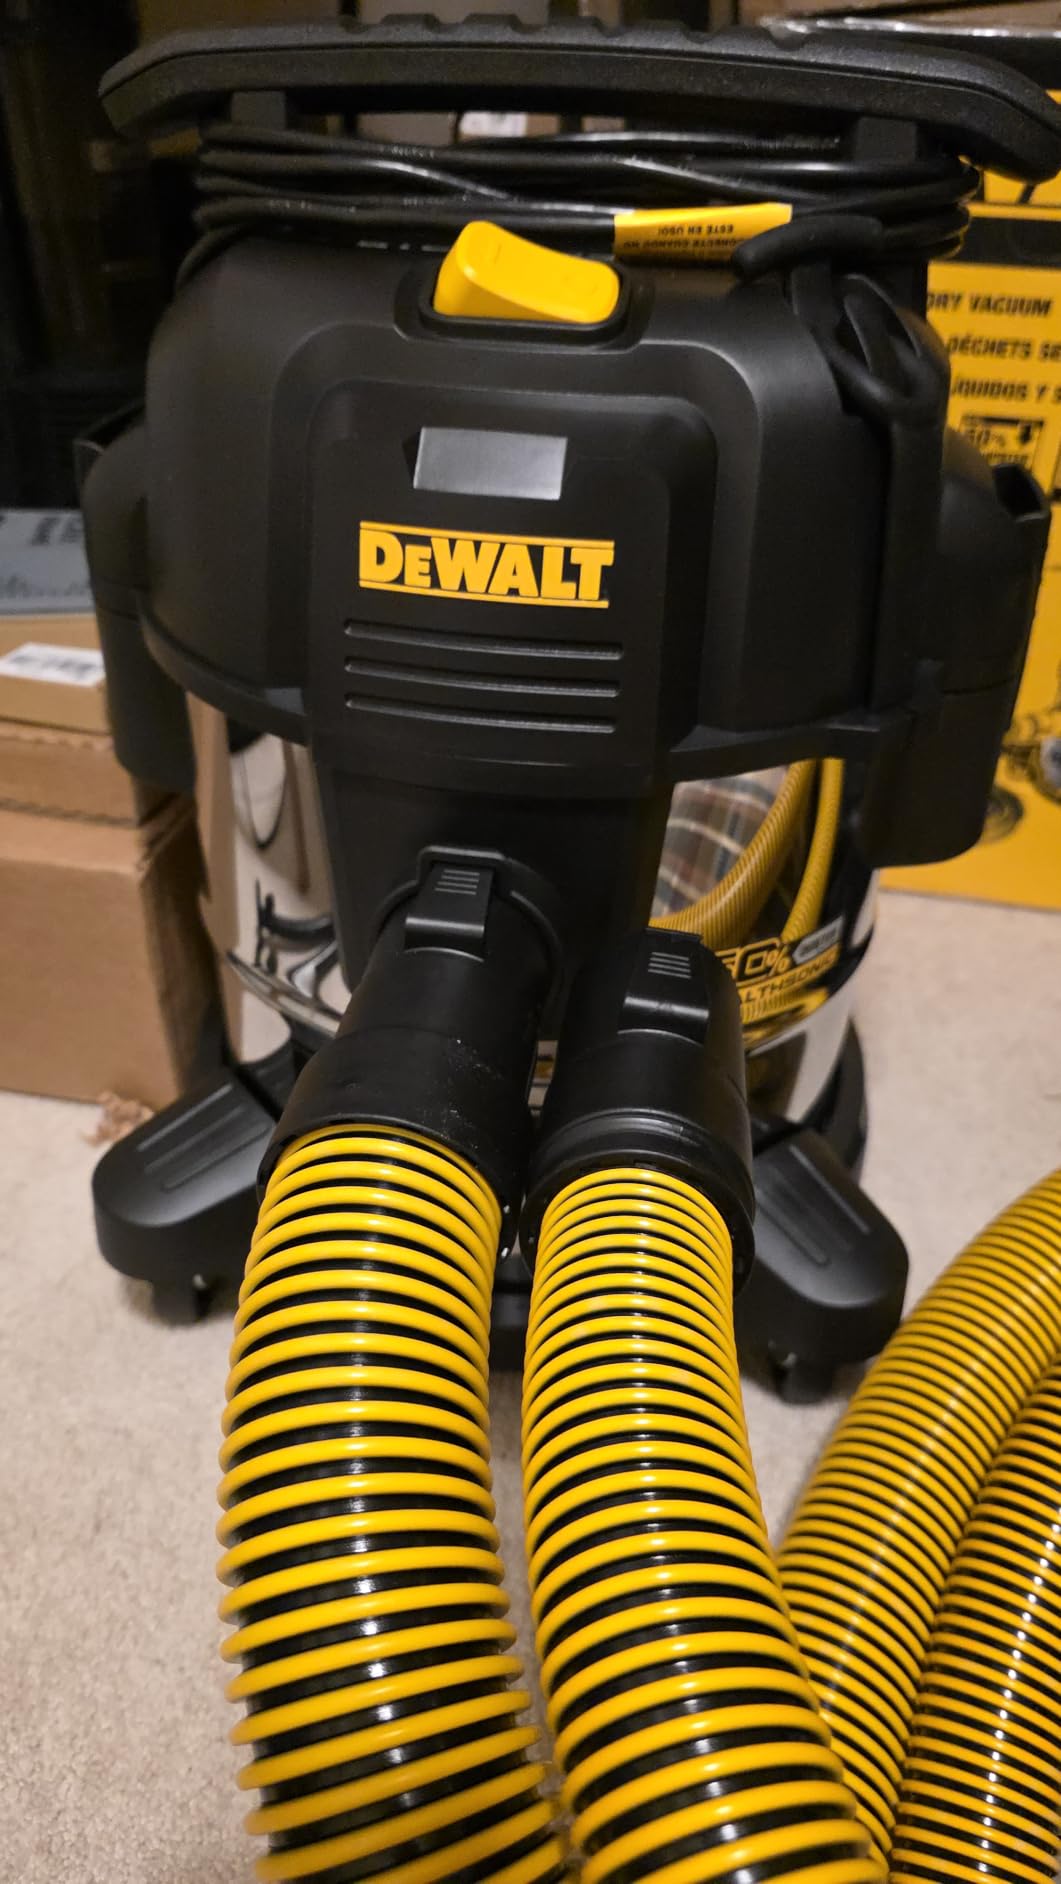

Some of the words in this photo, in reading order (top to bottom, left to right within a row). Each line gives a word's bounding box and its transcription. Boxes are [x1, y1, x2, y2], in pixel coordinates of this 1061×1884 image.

[968, 293, 1053, 318] VACUUM
[946, 333, 1032, 361] DÉCHETS
[359, 527, 615, 601] DEWALT
